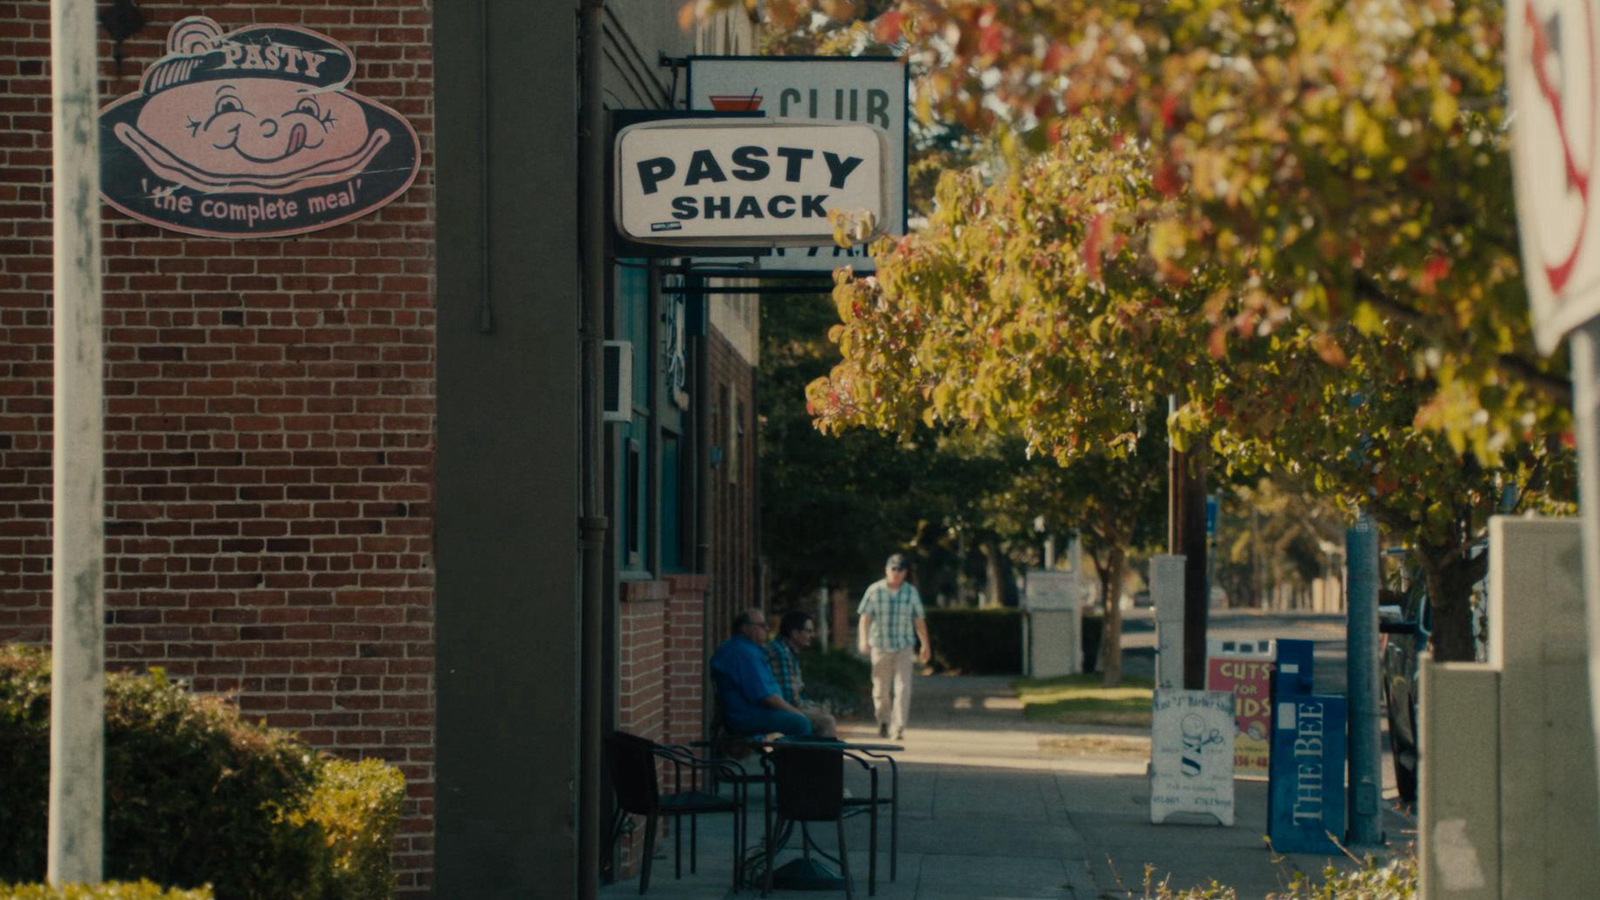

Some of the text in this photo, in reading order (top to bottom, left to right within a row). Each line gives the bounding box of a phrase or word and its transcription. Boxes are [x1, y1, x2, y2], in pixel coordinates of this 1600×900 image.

[222, 41, 326, 78] PASTY
[636, 145, 864, 195] PASTY
[200, 196, 299, 228] complete
[671, 194, 830, 220] SHACK
[1220, 662, 1271, 681] CUTS
[1235, 697, 1272, 717] IDS
[1293, 702, 1323, 826] THE BEE
